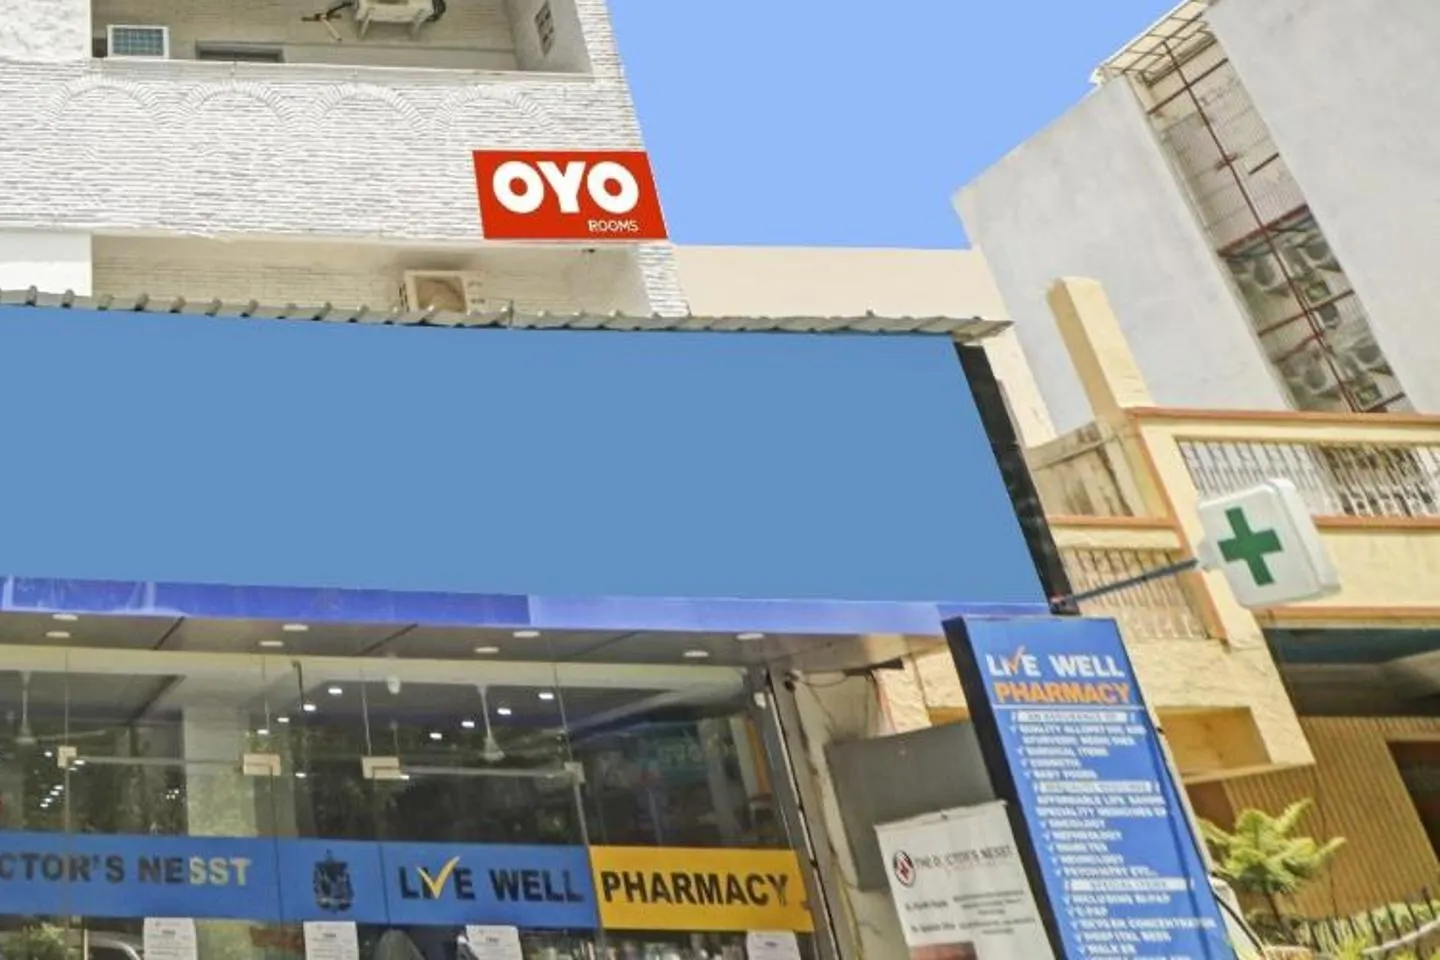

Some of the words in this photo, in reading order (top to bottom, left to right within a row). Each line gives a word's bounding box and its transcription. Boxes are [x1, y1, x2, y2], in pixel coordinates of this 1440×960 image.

[492, 160, 639, 213] OYO
[588, 219, 639, 232] ROOMS
[1048, 654, 1125, 677] WELL
[994, 682, 1130, 704] PHARMACY
[138, 855, 252, 886] NESST
[488, 868, 585, 902] WELL
[603, 871, 788, 907] PHARMACY
